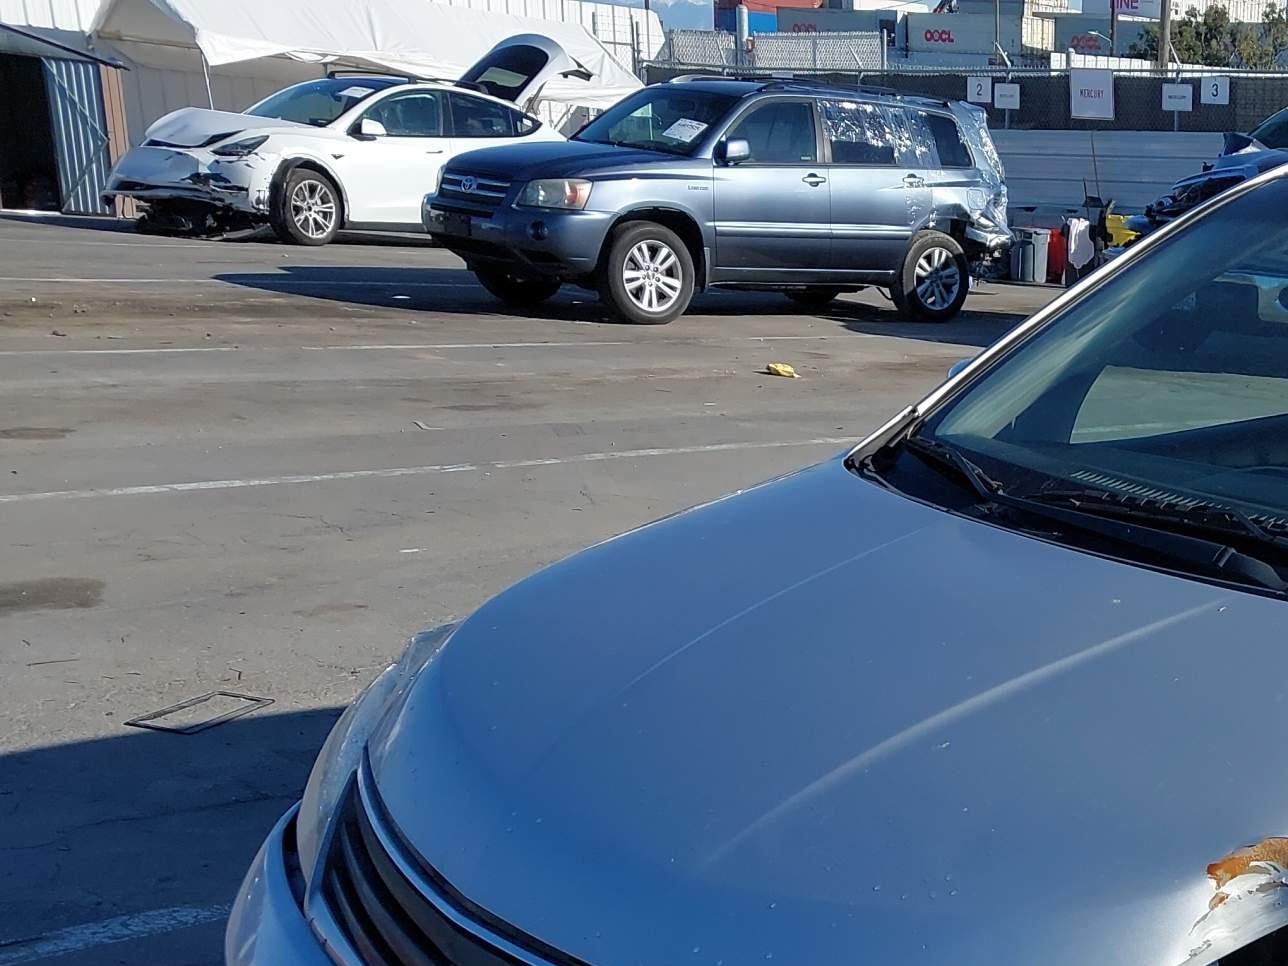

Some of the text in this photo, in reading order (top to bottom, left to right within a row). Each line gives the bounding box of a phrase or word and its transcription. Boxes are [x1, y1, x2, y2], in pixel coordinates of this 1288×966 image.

[924, 29, 955, 43] OOCL
[976, 83, 983, 96] 2
[1079, 89, 1104, 98] MERCURY
[1211, 83, 1219, 97] 3
